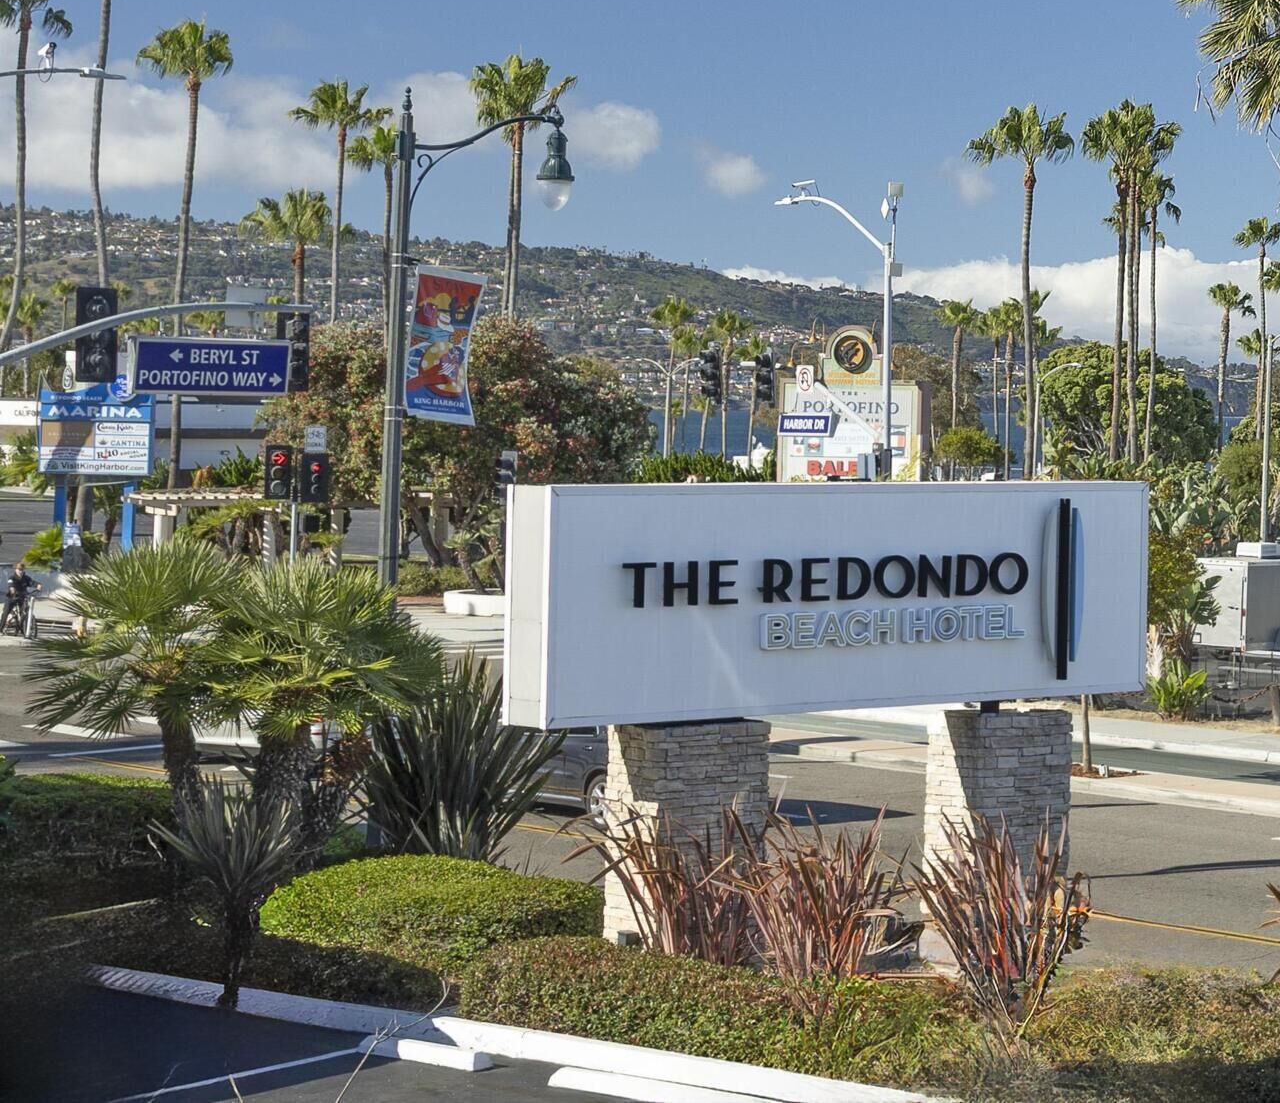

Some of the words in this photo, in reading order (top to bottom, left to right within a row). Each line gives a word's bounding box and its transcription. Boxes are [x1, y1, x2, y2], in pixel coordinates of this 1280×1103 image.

[190, 349, 236, 365] BERYL
[241, 350, 260, 365] ST
[138, 369, 228, 386] PORTOFINO
[232, 372, 267, 387] WAY
[414, 397, 432, 405] KING
[432, 398, 465, 409] HARBOR
[48, 405, 142, 418] MARINA
[783, 419, 813, 430] HARBOR
[814, 419, 825, 430] DR
[61, 462, 145, 471] VisitKingHarbor.com
[622, 559, 738, 608] THE
[760, 552, 1029, 603] REDONDO
[760, 609, 897, 650] BEACH
[902, 604, 1025, 643] HOTEL
